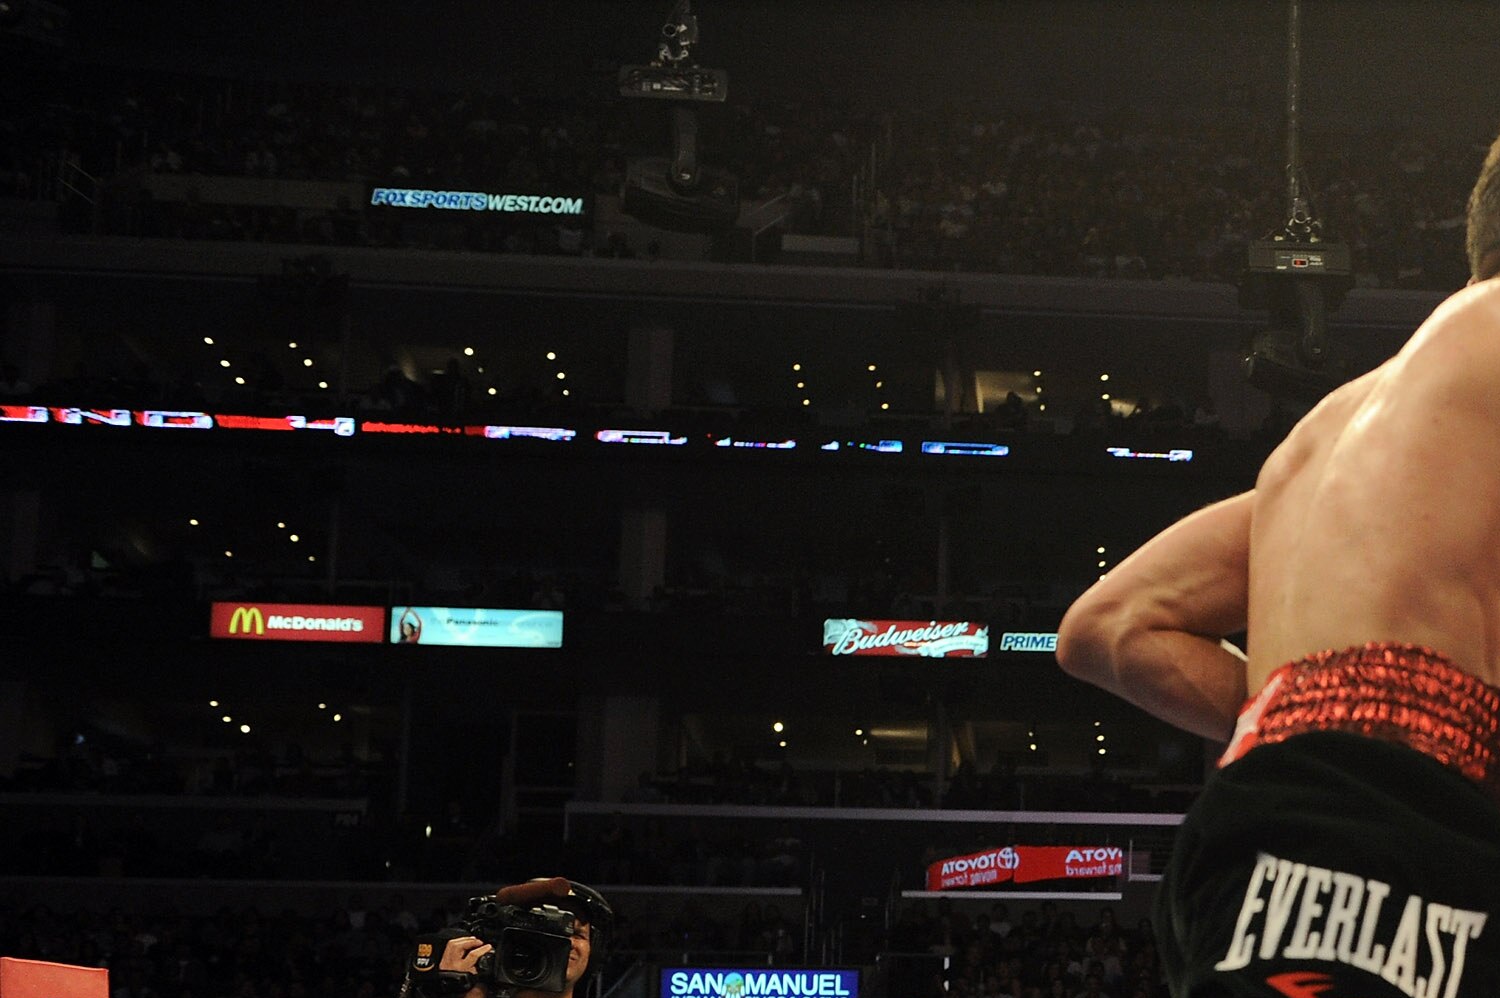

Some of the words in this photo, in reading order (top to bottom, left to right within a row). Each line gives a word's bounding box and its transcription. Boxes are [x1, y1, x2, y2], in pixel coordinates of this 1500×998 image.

[268, 615, 364, 633] McDonald's
[832, 620, 969, 656] Budweiser
[671, 972, 724, 995] SAN
[745, 973, 850, 996] MANUEL
